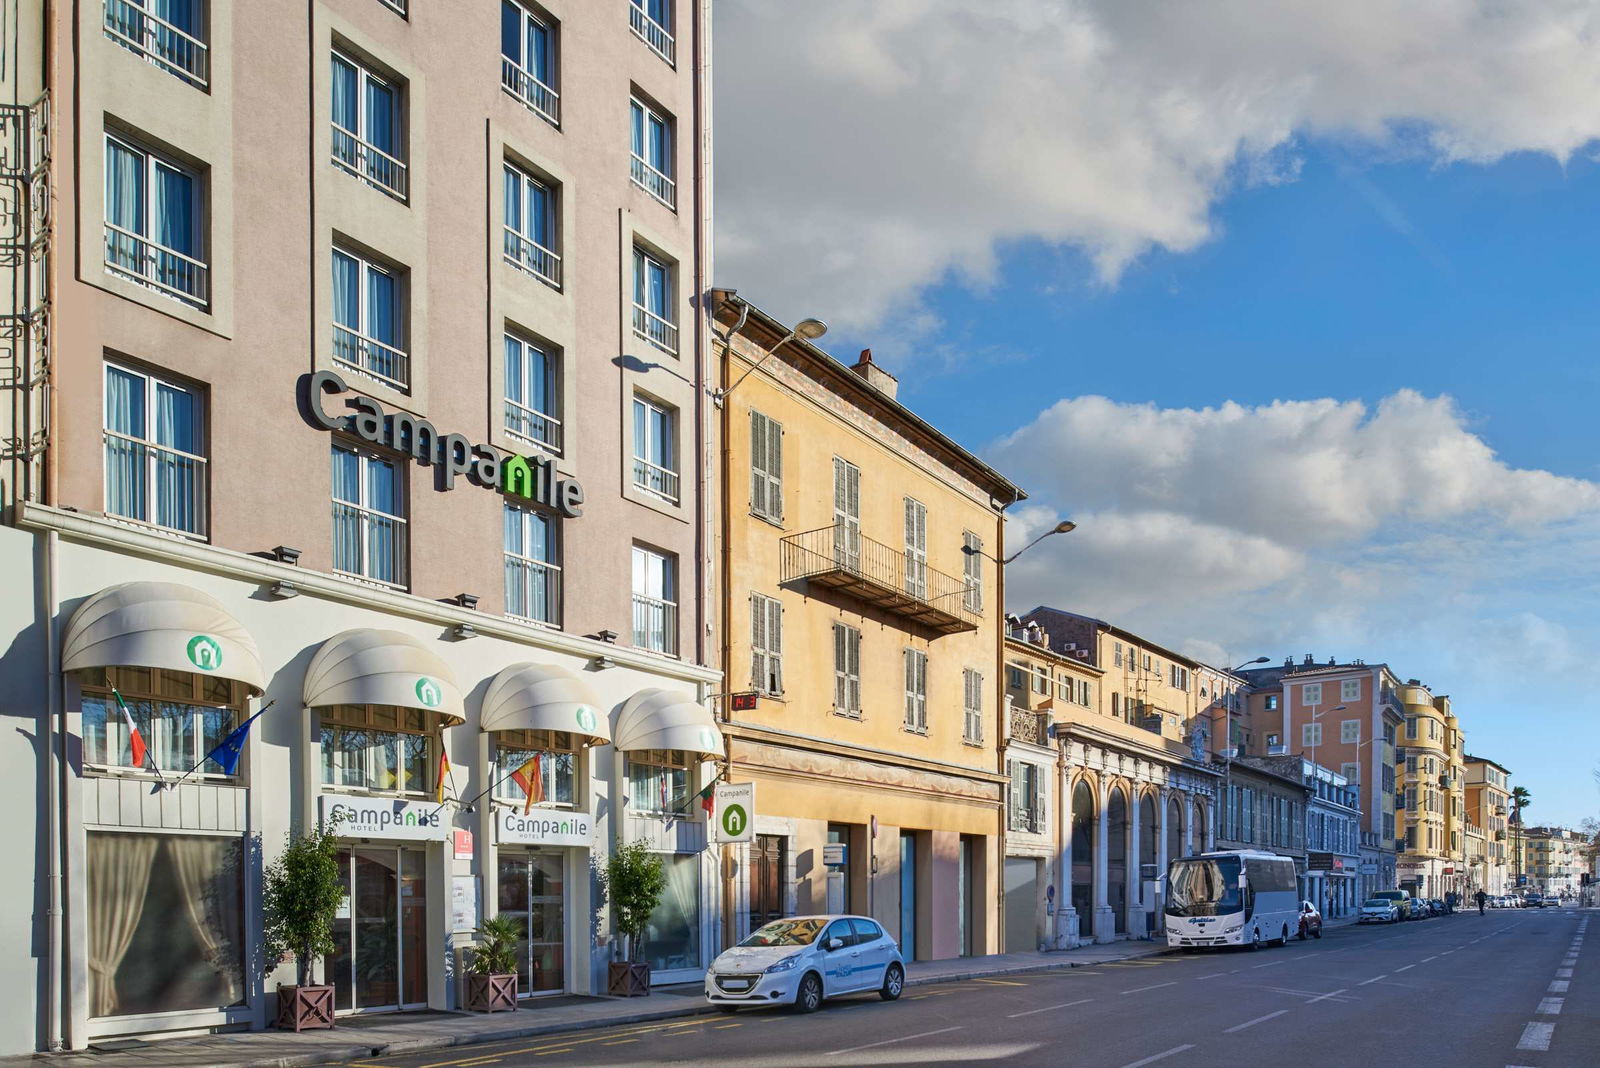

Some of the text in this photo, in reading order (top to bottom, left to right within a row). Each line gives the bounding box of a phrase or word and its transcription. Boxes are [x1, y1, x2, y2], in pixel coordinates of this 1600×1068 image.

[296, 370, 584, 518] Campanile
[719, 788, 750, 798] Campanile
[331, 803, 439, 831] Campanile
[505, 815, 586, 839] Campanile
